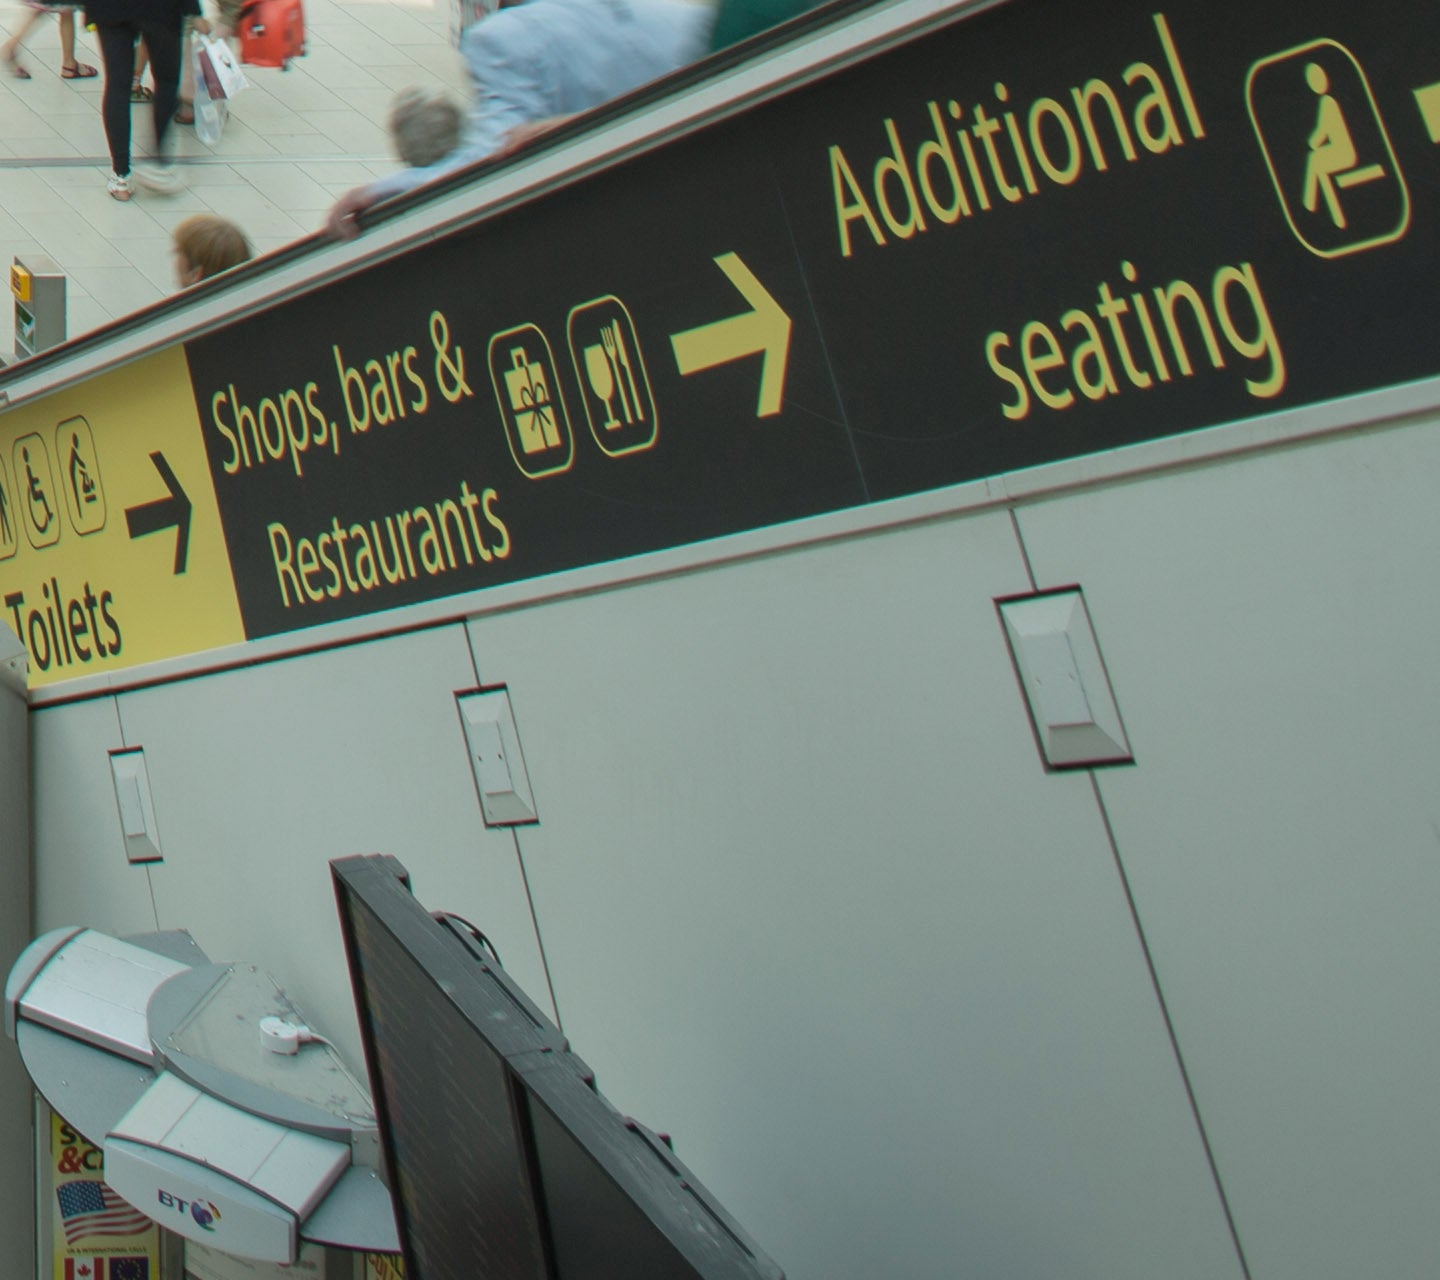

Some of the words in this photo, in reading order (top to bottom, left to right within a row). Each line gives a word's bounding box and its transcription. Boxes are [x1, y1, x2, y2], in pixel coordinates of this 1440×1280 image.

[828, 11, 1207, 259] Additional
[210, 379, 341, 476] Shops,
[332, 344, 428, 432] bars
[429, 309, 473, 404] &
[984, 259, 1286, 421] seating
[266, 480, 512, 609] Restaurants
[4, 577, 122, 673] Toilets
[157, 1188, 189, 1214] BT
